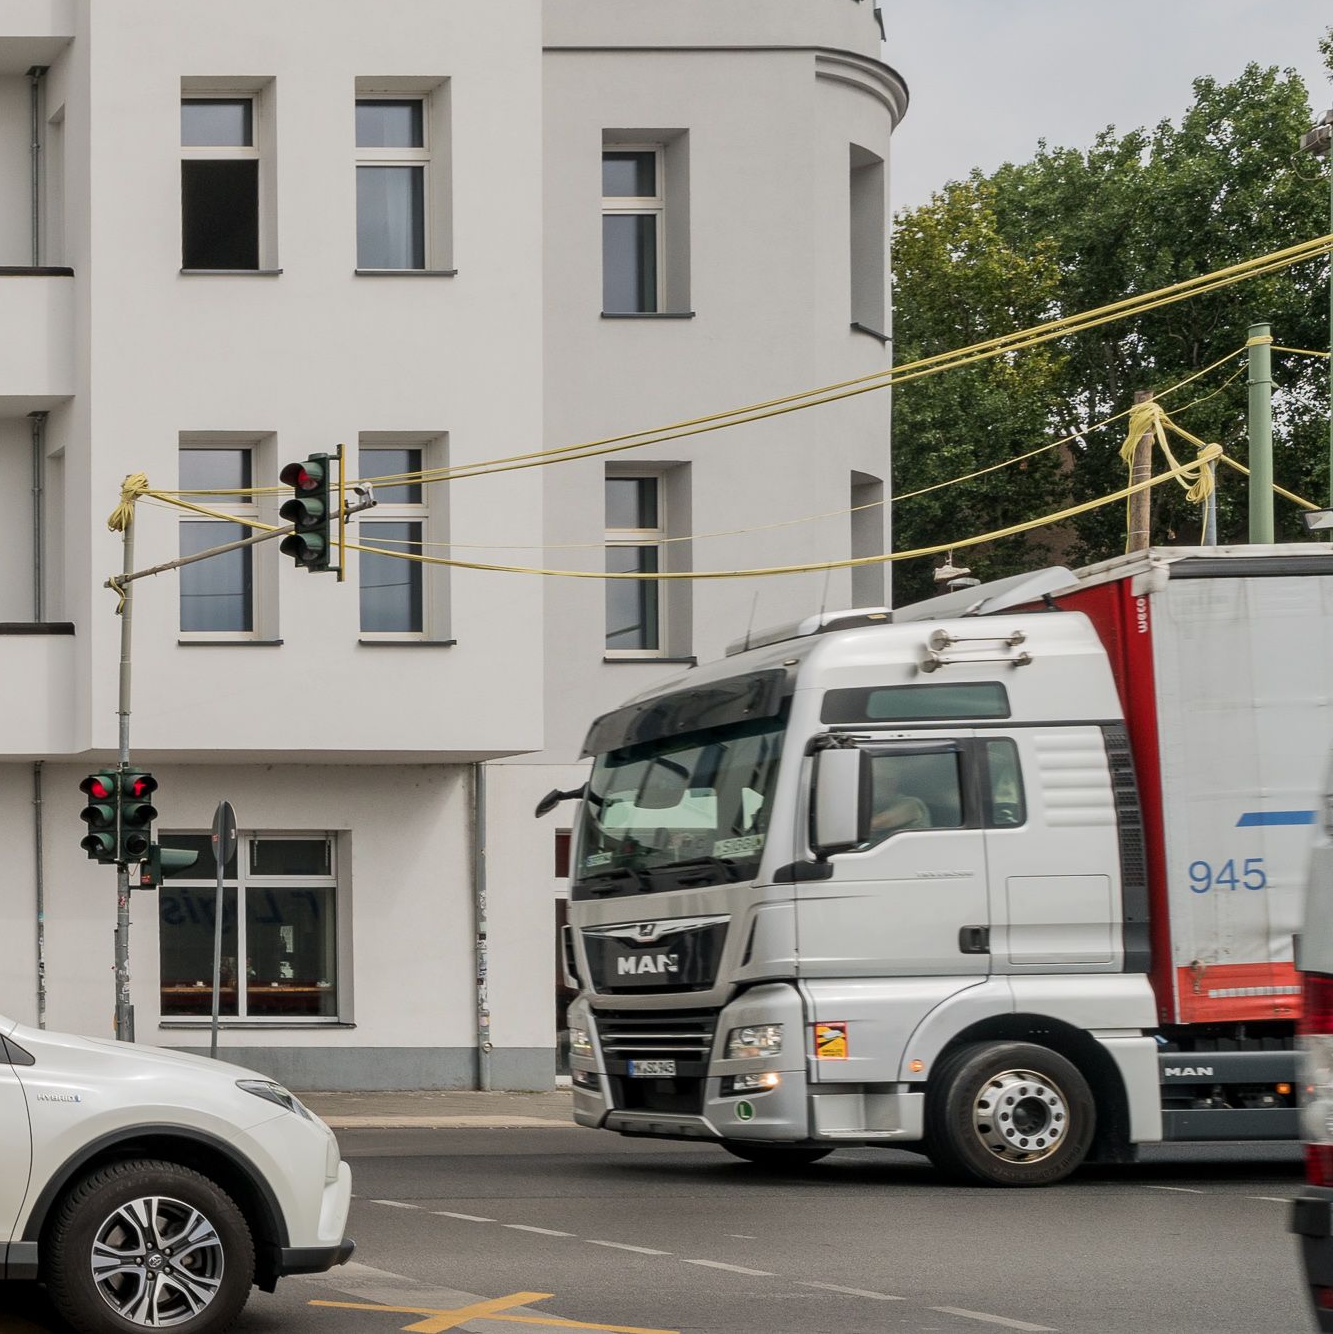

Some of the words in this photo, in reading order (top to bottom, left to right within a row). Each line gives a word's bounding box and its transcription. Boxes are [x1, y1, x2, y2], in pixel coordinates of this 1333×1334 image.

[1136, 596, 1149, 633] weco
[1188, 858, 1267, 894] 945
[617, 954, 679, 975] MAN
[1164, 1067, 1214, 1077] MAN
[37, 1094, 74, 1102] HYBRID
